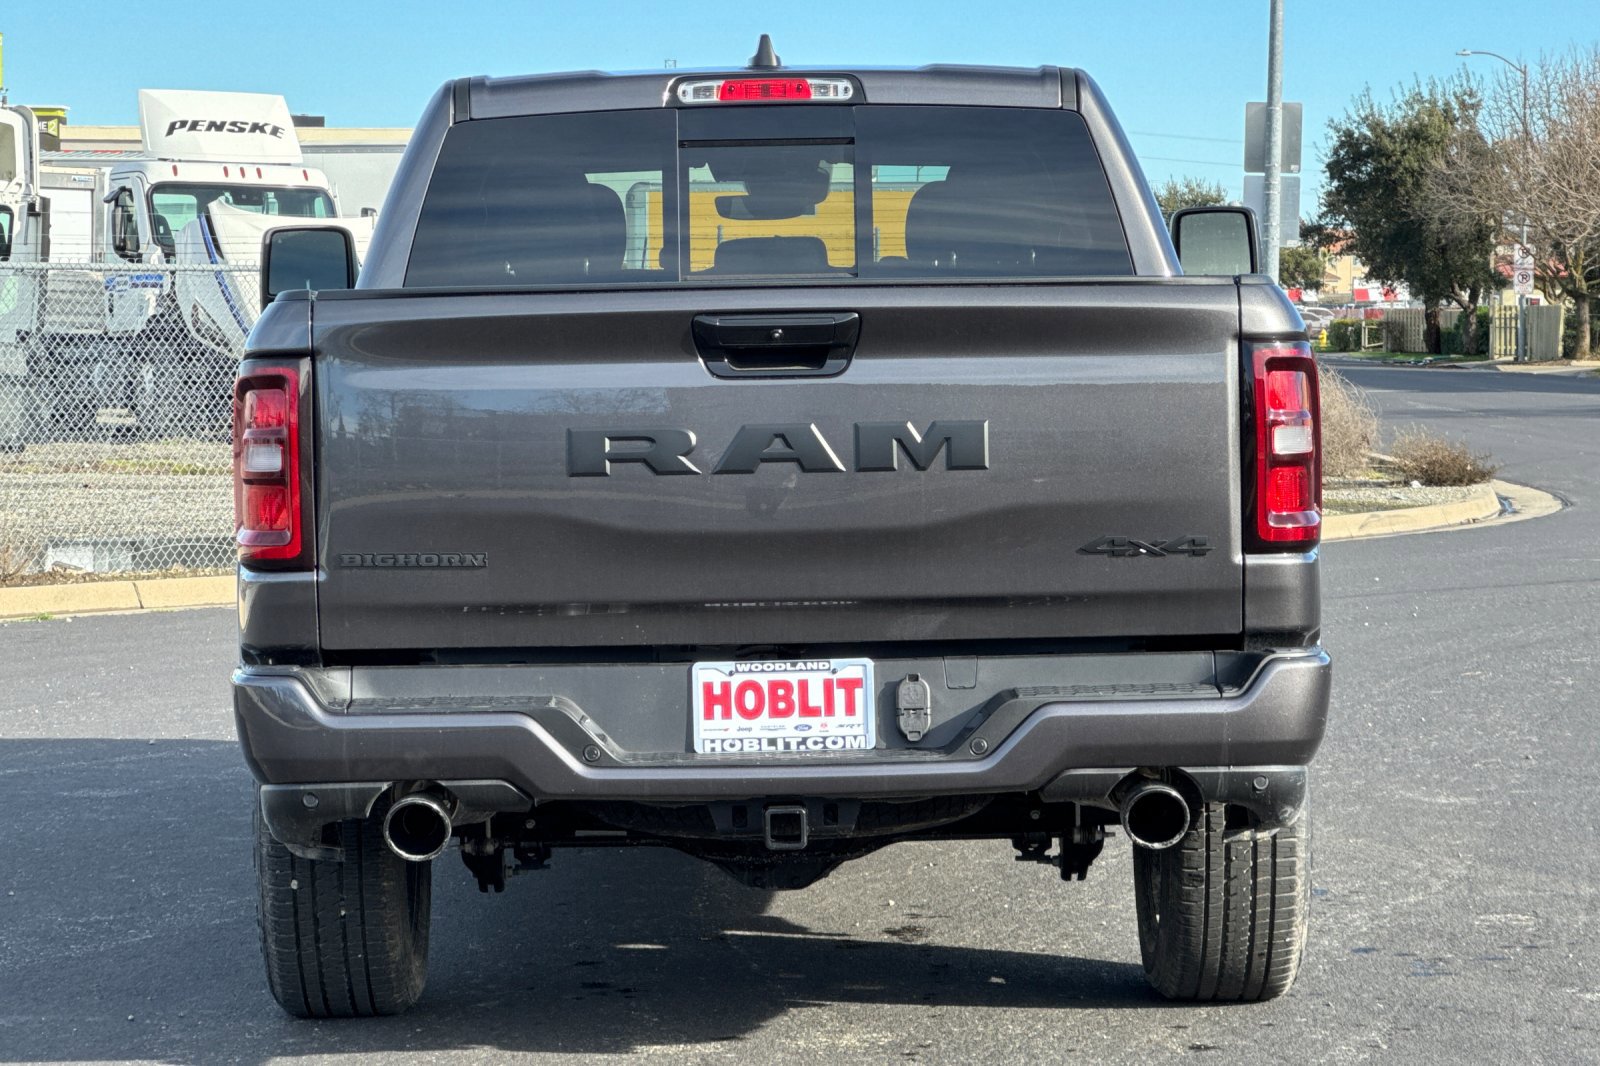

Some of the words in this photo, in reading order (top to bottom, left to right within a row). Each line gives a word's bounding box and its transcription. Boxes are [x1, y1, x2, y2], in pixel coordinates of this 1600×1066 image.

[165, 119, 285, 139] PENSKE
[567, 419, 989, 477] RAM
[340, 552, 488, 567] BIGHORN
[736, 661, 830, 672] WOODLAND
[703, 678, 863, 720] HOBLIT
[704, 736, 866, 752] HOBLIT.COM
